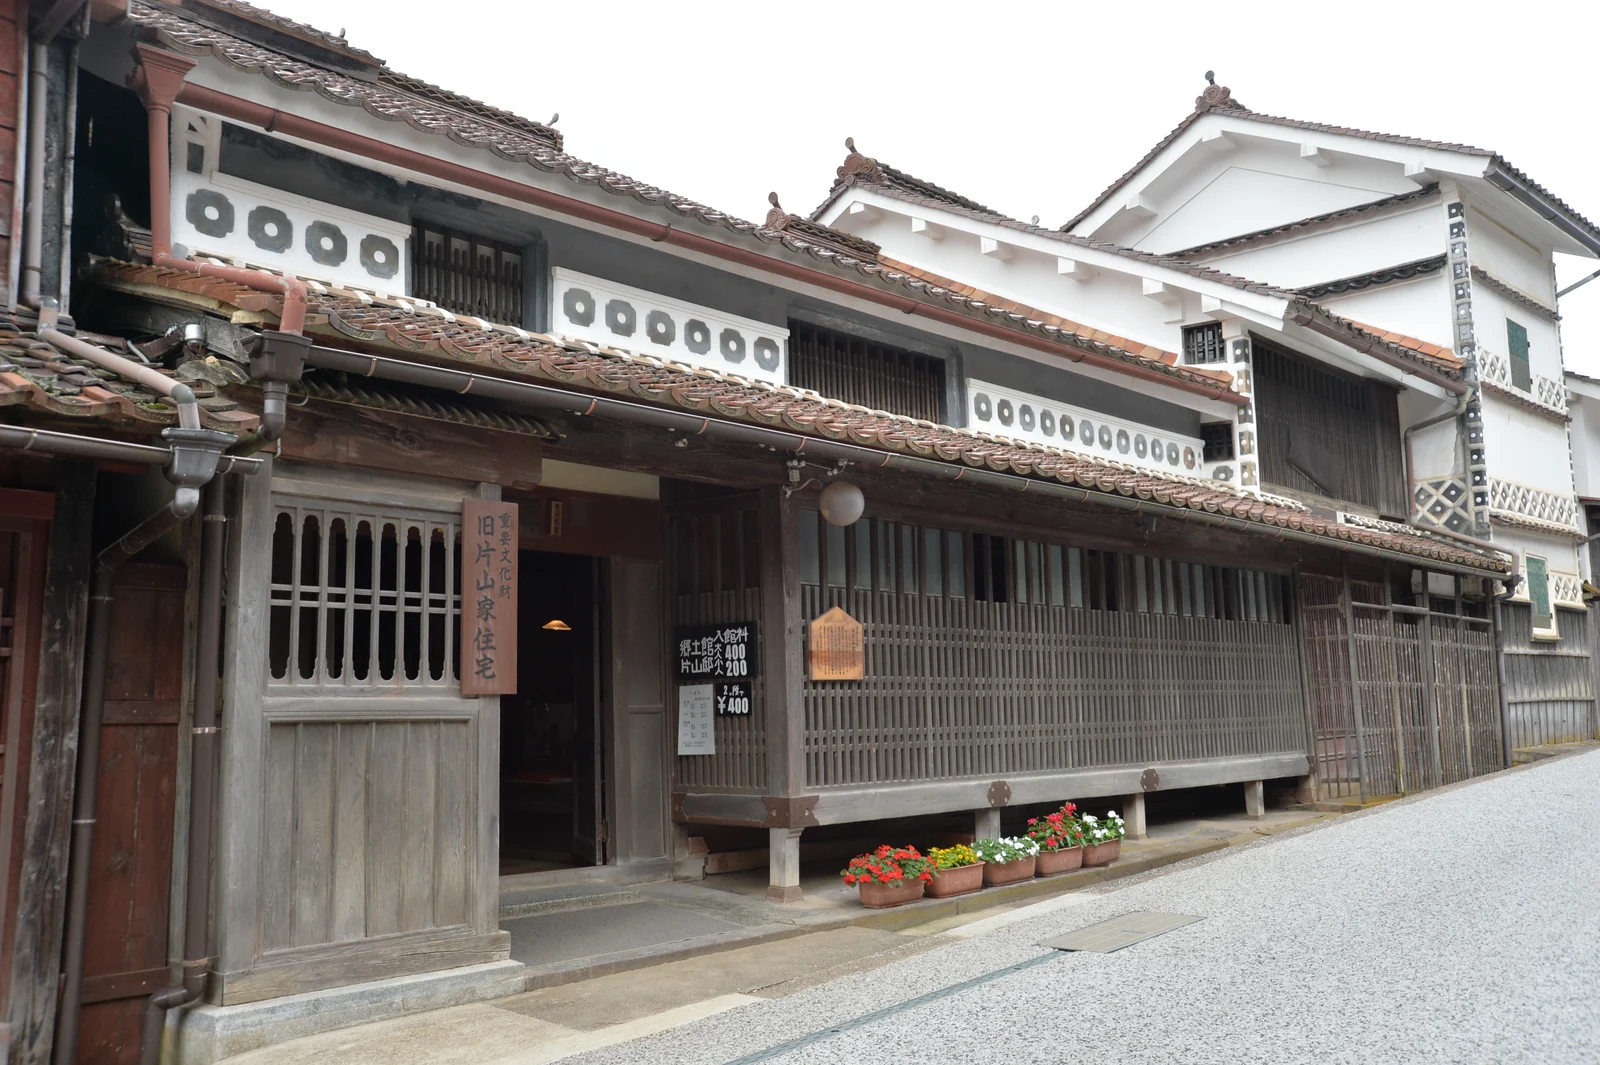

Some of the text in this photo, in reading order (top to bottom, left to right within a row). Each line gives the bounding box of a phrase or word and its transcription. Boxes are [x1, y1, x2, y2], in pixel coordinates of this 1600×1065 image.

[498, 512, 512, 600] 重要文化財
[474, 515, 497, 680] 旧片山家住宅
[713, 626, 748, 643] 入館料
[680, 637, 713, 657] 郷土館
[725, 643, 745, 660] 400
[681, 656, 713, 673] 片山邸
[726, 660, 747, 676] 200
[717, 696, 748, 714] ¥400
